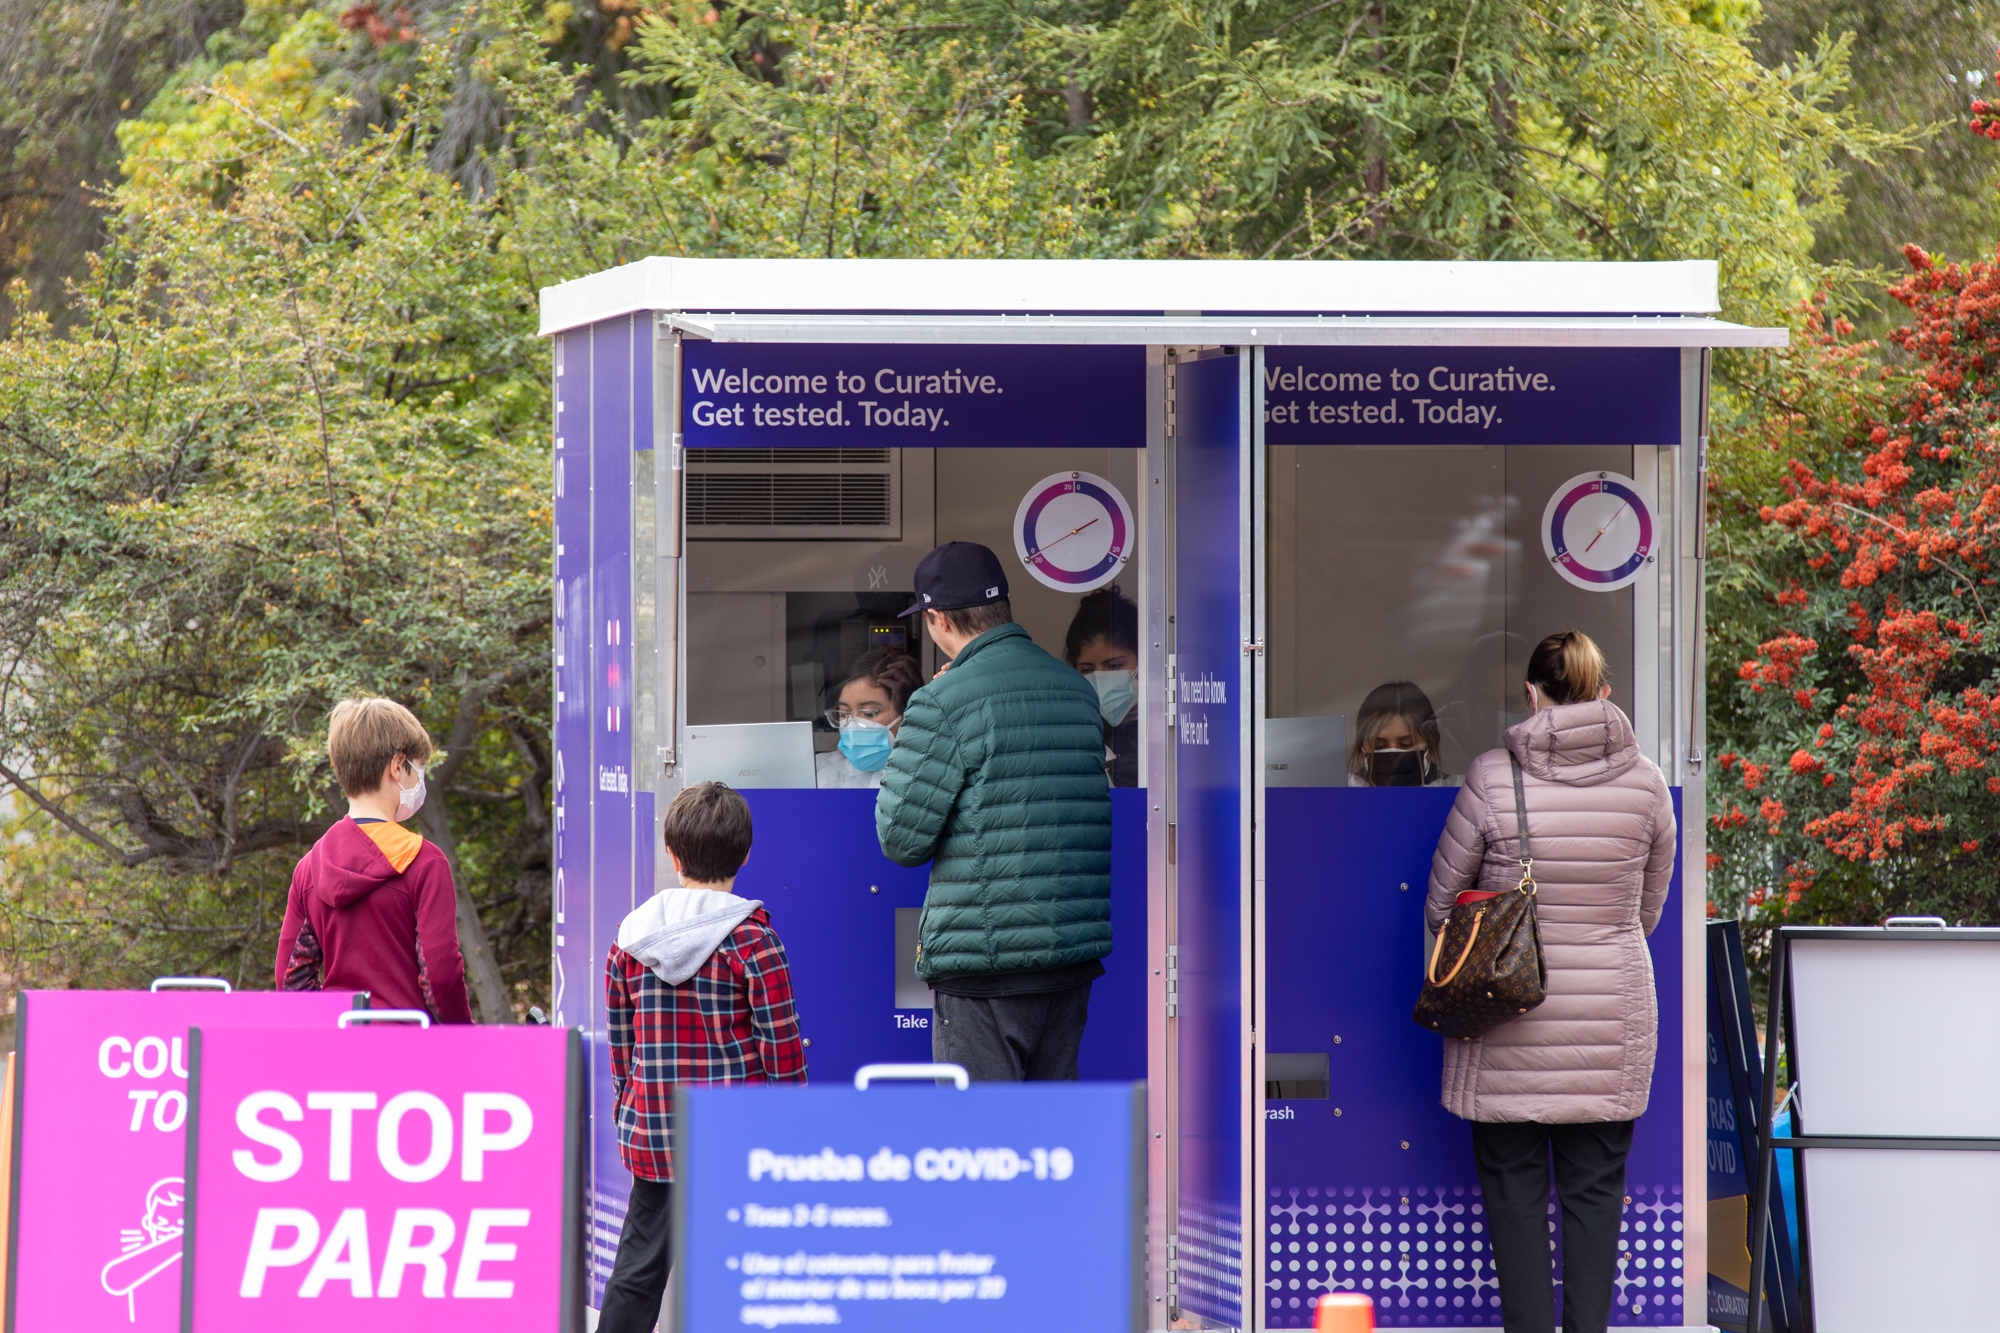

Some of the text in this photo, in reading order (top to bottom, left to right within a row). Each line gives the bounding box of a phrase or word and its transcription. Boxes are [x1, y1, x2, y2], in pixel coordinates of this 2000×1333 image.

[691, 368, 1004, 393] Welcome to Curative.
[1390, 368, 1420, 391] to
[1429, 366, 1556, 391] Curative.
[556, 334, 565, 498] SITE
[691, 401, 950, 431] Get tested. Today.
[1264, 399, 1503, 429] et tested. Today.
[556, 524, 565, 723] TEST
[1180, 671, 1227, 704] You need to know.
[1180, 712, 1196, 745] We're
[1195, 722, 1204, 745] on
[605, 765, 618, 792] tested.
[617, 765, 629, 799] Today.
[893, 1014, 929, 1029] Take
[232, 1089, 534, 1183] STOP
[747, 1146, 1074, 1182] Prueba de COVID-19
[239, 1207, 531, 1299] PARE
